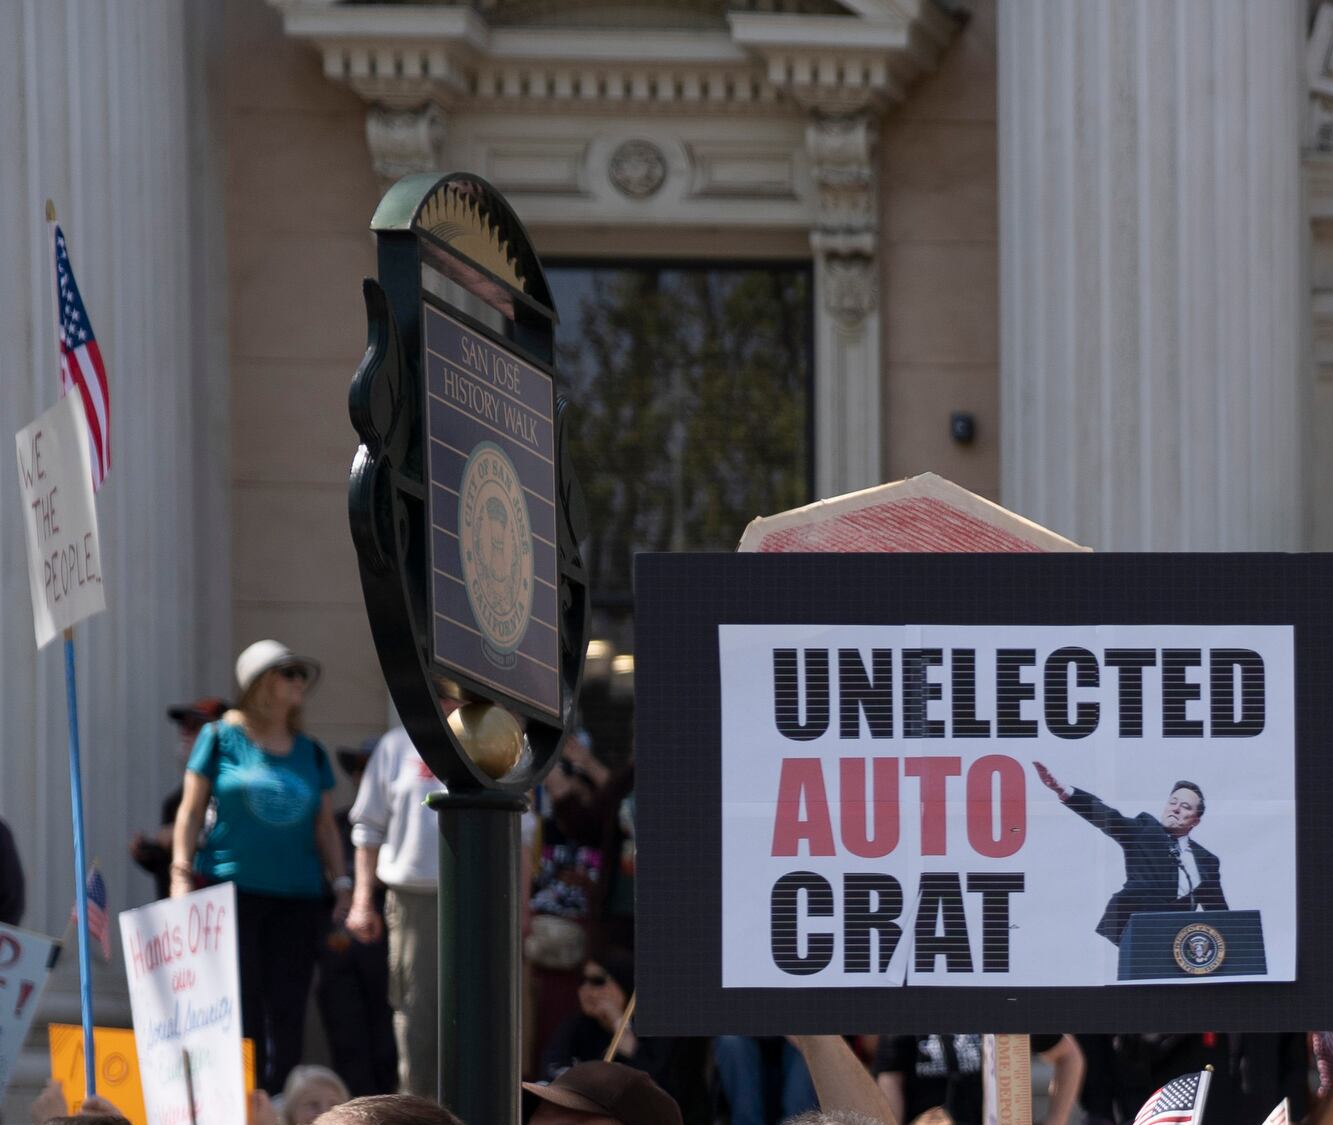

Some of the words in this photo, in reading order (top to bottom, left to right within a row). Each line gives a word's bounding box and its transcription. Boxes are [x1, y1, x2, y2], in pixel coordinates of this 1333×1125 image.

[461, 335, 488, 376] SAN
[492, 353, 521, 395] JOSÉ
[443, 367, 500, 423] HISTORY
[503, 401, 540, 447] WALK
[18, 430, 47, 489] WE
[464, 475, 478, 528] CITY
[477, 458, 490, 479] OF
[492, 460, 513, 493] SAN
[31, 486, 60, 545] THE
[472, 578, 526, 636] CALIFORNIA
[771, 646, 1267, 742] UNELECTED
[770, 753, 1028, 859] AUTO
[130, 919, 184, 980] Hands
[187, 900, 226, 955] Off
[770, 870, 1026, 977] CRAT
